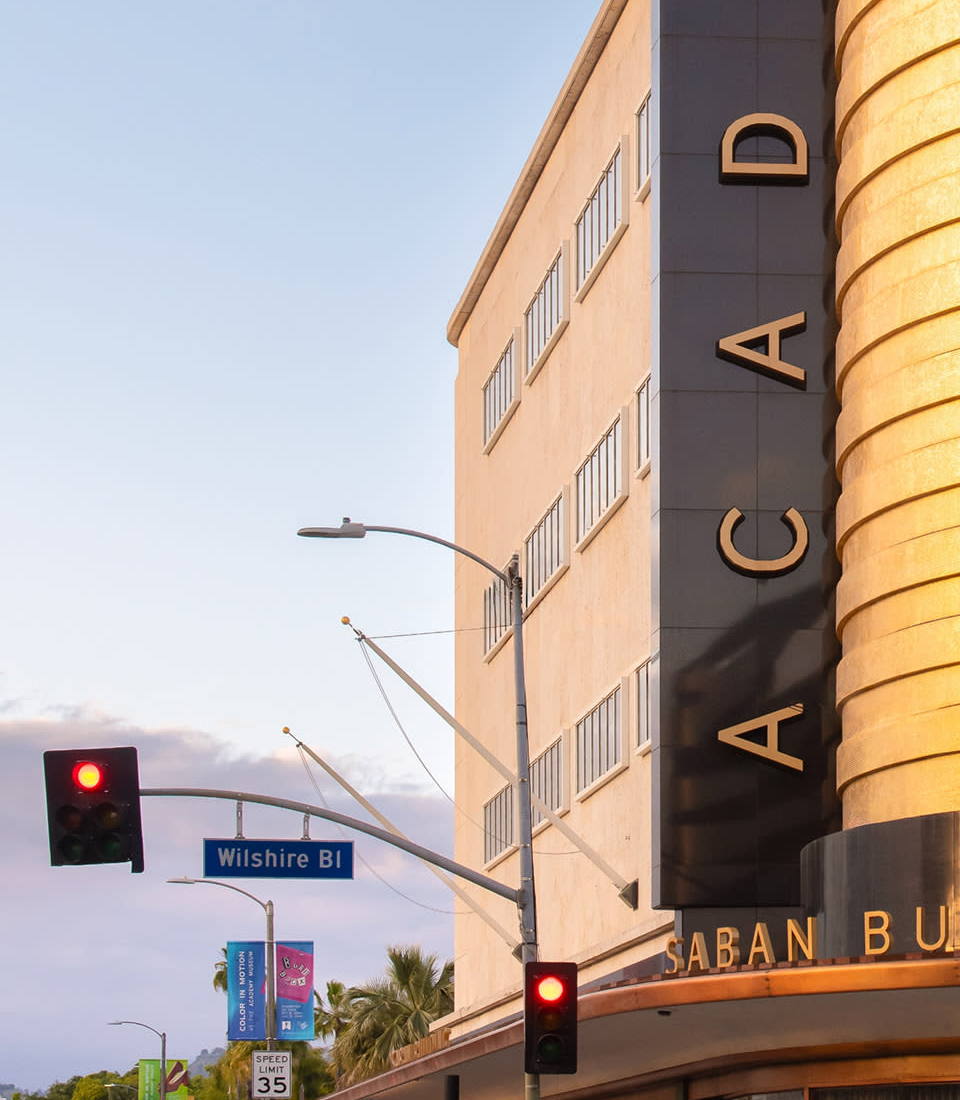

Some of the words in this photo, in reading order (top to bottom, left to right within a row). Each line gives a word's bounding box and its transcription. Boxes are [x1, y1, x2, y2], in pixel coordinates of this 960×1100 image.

[217, 847, 309, 869] Wilshire
[319, 849, 342, 869] Bl
[665, 916, 818, 974] SABAN
[240, 991, 246, 999] IN
[256, 1055, 289, 1063] SPEED
[259, 1066, 285, 1074] LIMIT
[257, 1076, 288, 1094] 35
